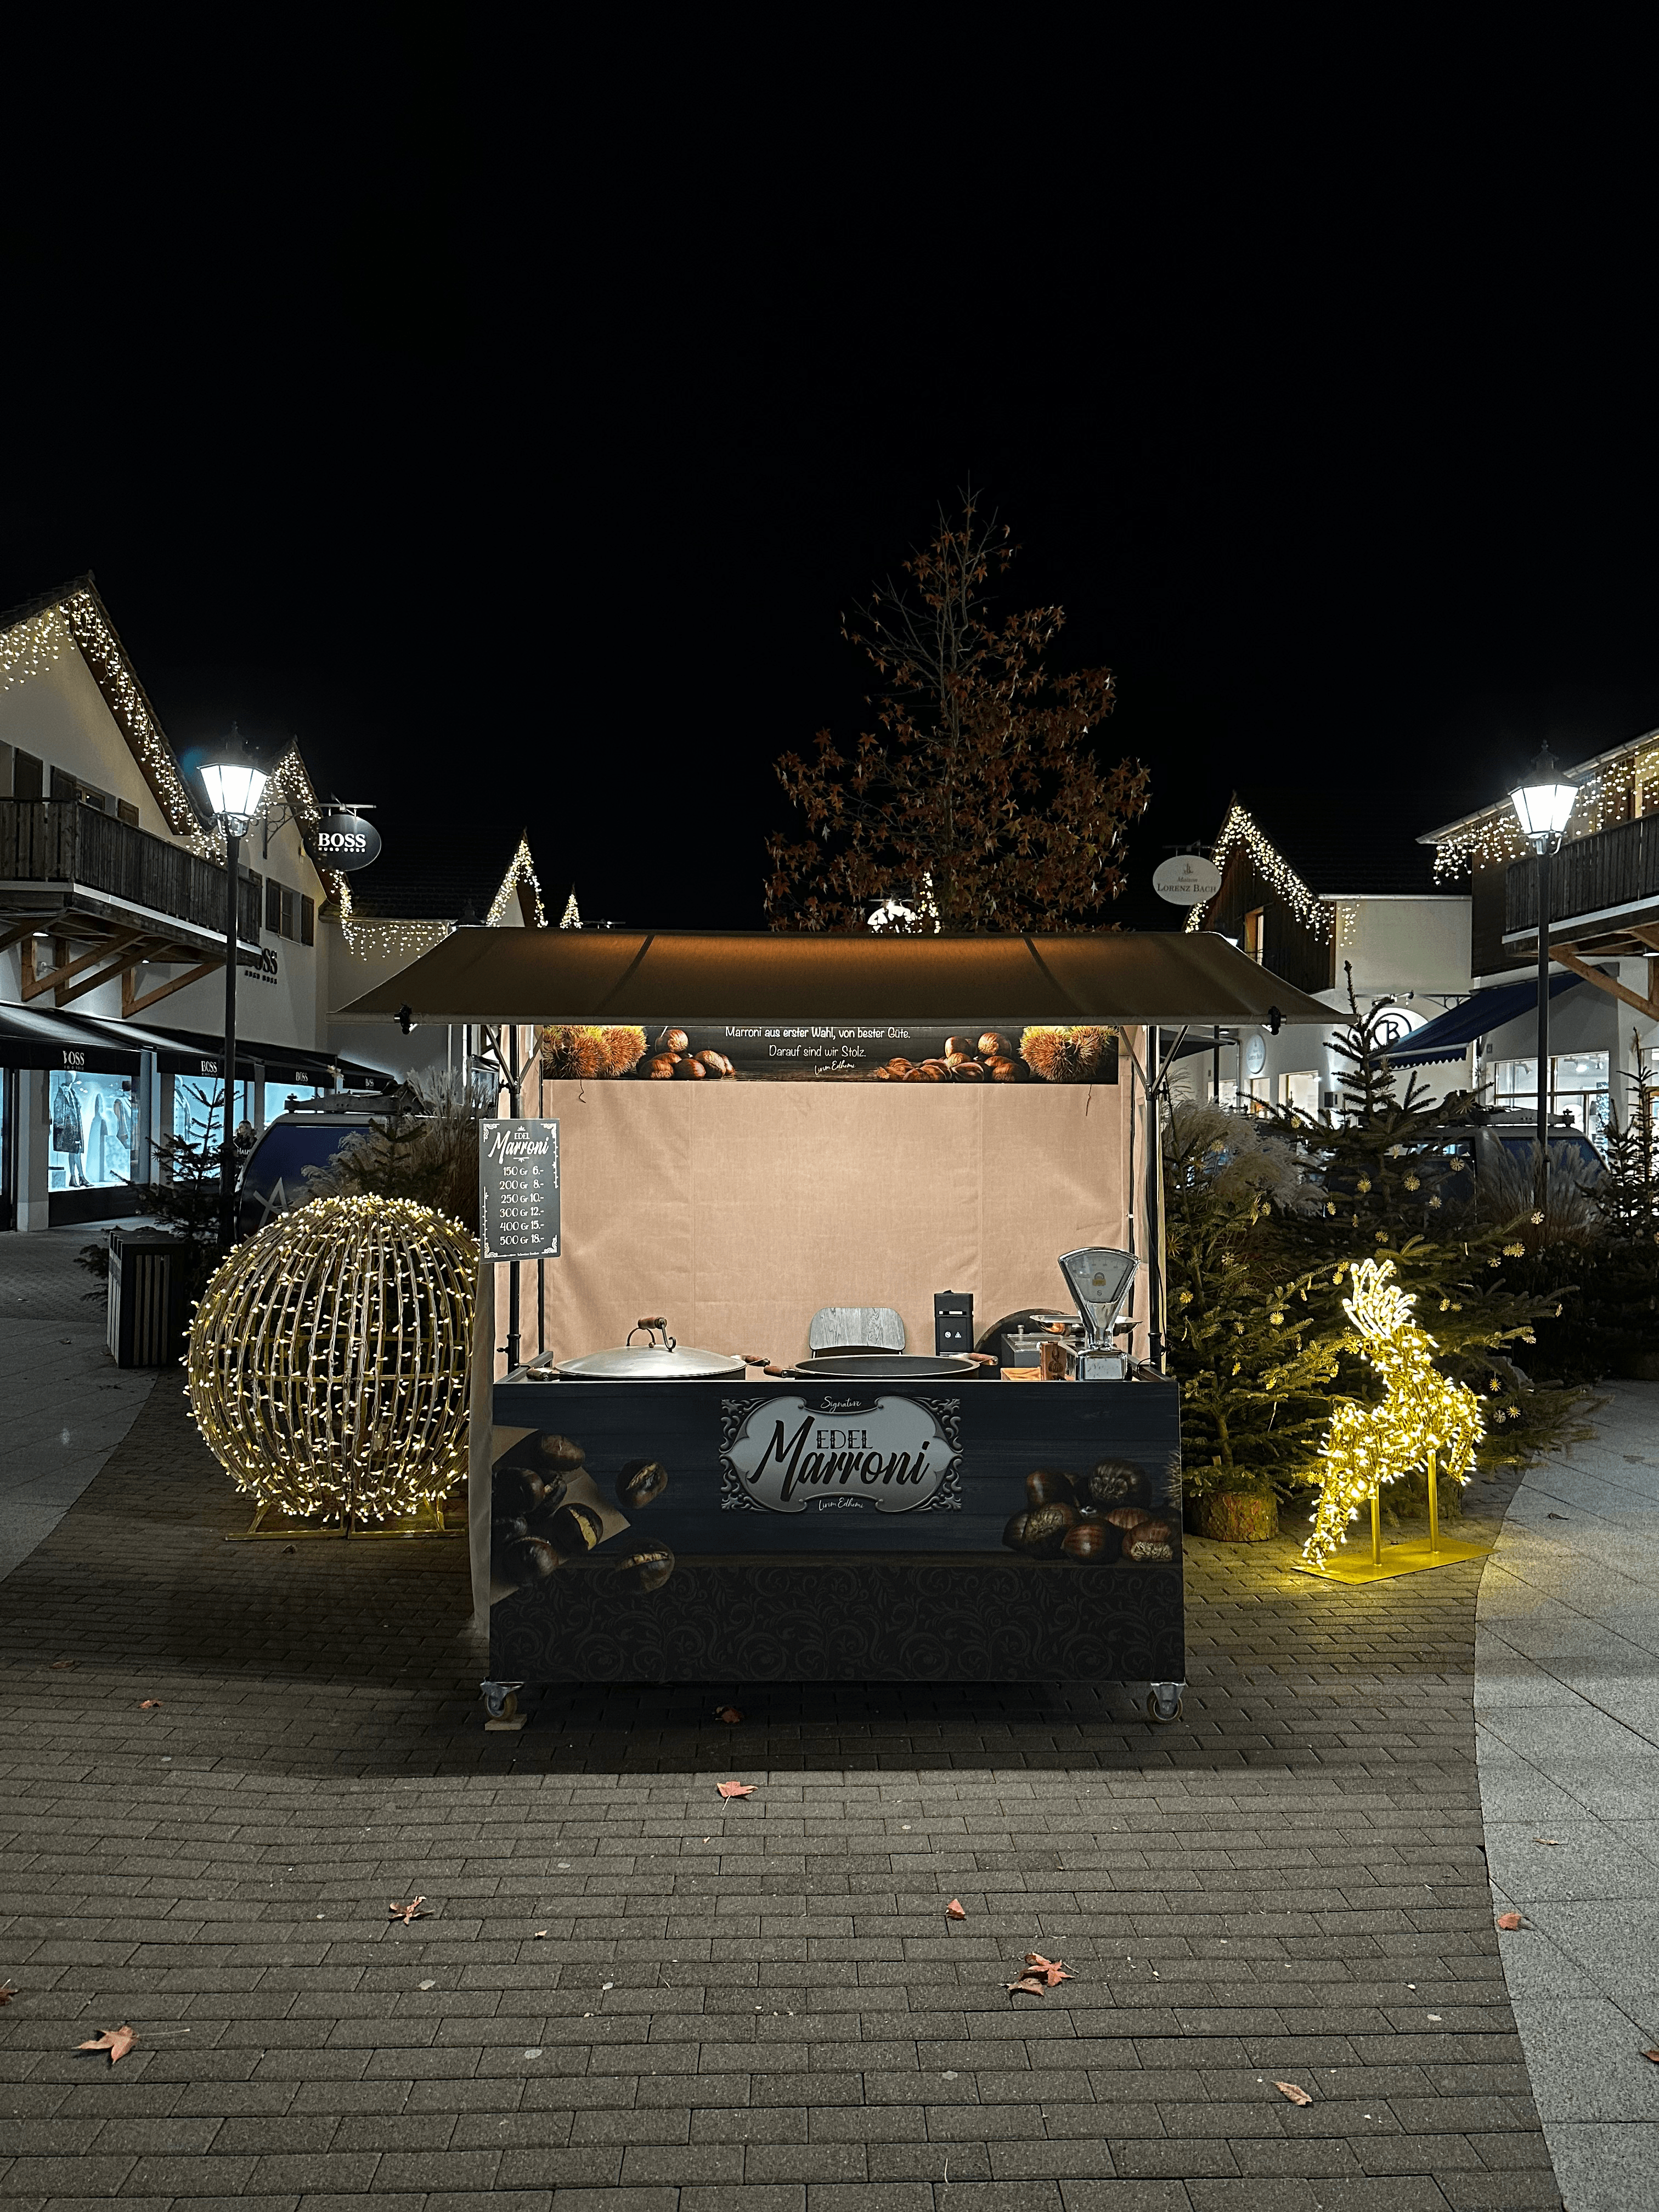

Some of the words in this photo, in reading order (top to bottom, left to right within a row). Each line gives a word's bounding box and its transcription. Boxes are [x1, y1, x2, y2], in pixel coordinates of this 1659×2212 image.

[318, 833, 366, 848] BOSS
[250, 948, 278, 975] OSS
[725, 1026, 762, 1037] Marroni
[764, 1029, 781, 1038] aus
[783, 1027, 809, 1038] erster
[811, 1026, 836, 1040] Wahl,
[838, 1030, 855, 1038] von
[857, 1027, 885, 1039] bester
[888, 1027, 911, 1039] Güte.
[769, 1045, 802, 1057] Darauf
[803, 1045, 822, 1057] sind
[825, 1047, 839, 1057] wir
[841, 1045, 867, 1057] Stolz.
[201, 1060, 217, 1073] BOSS
[487, 1130, 549, 1164] Marroni
[504, 1166, 518, 1176] 150
[532, 1165, 544, 1175] 6.-
[499, 1180, 518, 1190] 200
[533, 1179, 544, 1189] 8.-
[501, 1194, 518, 1204] 250
[530, 1193, 544, 1203] 10.-
[499, 1207, 518, 1217] 300
[531, 1206, 544, 1216] 12.-
[500, 1221, 519, 1231] 400
[531, 1220, 544, 1229] 15.-
[500, 1235, 518, 1245] 500
[531, 1233, 544, 1243] 18.-
[820, 1396, 862, 1413] Signature
[816, 1429, 873, 1449] EDEL
[747, 1415, 930, 1502] Marroni
